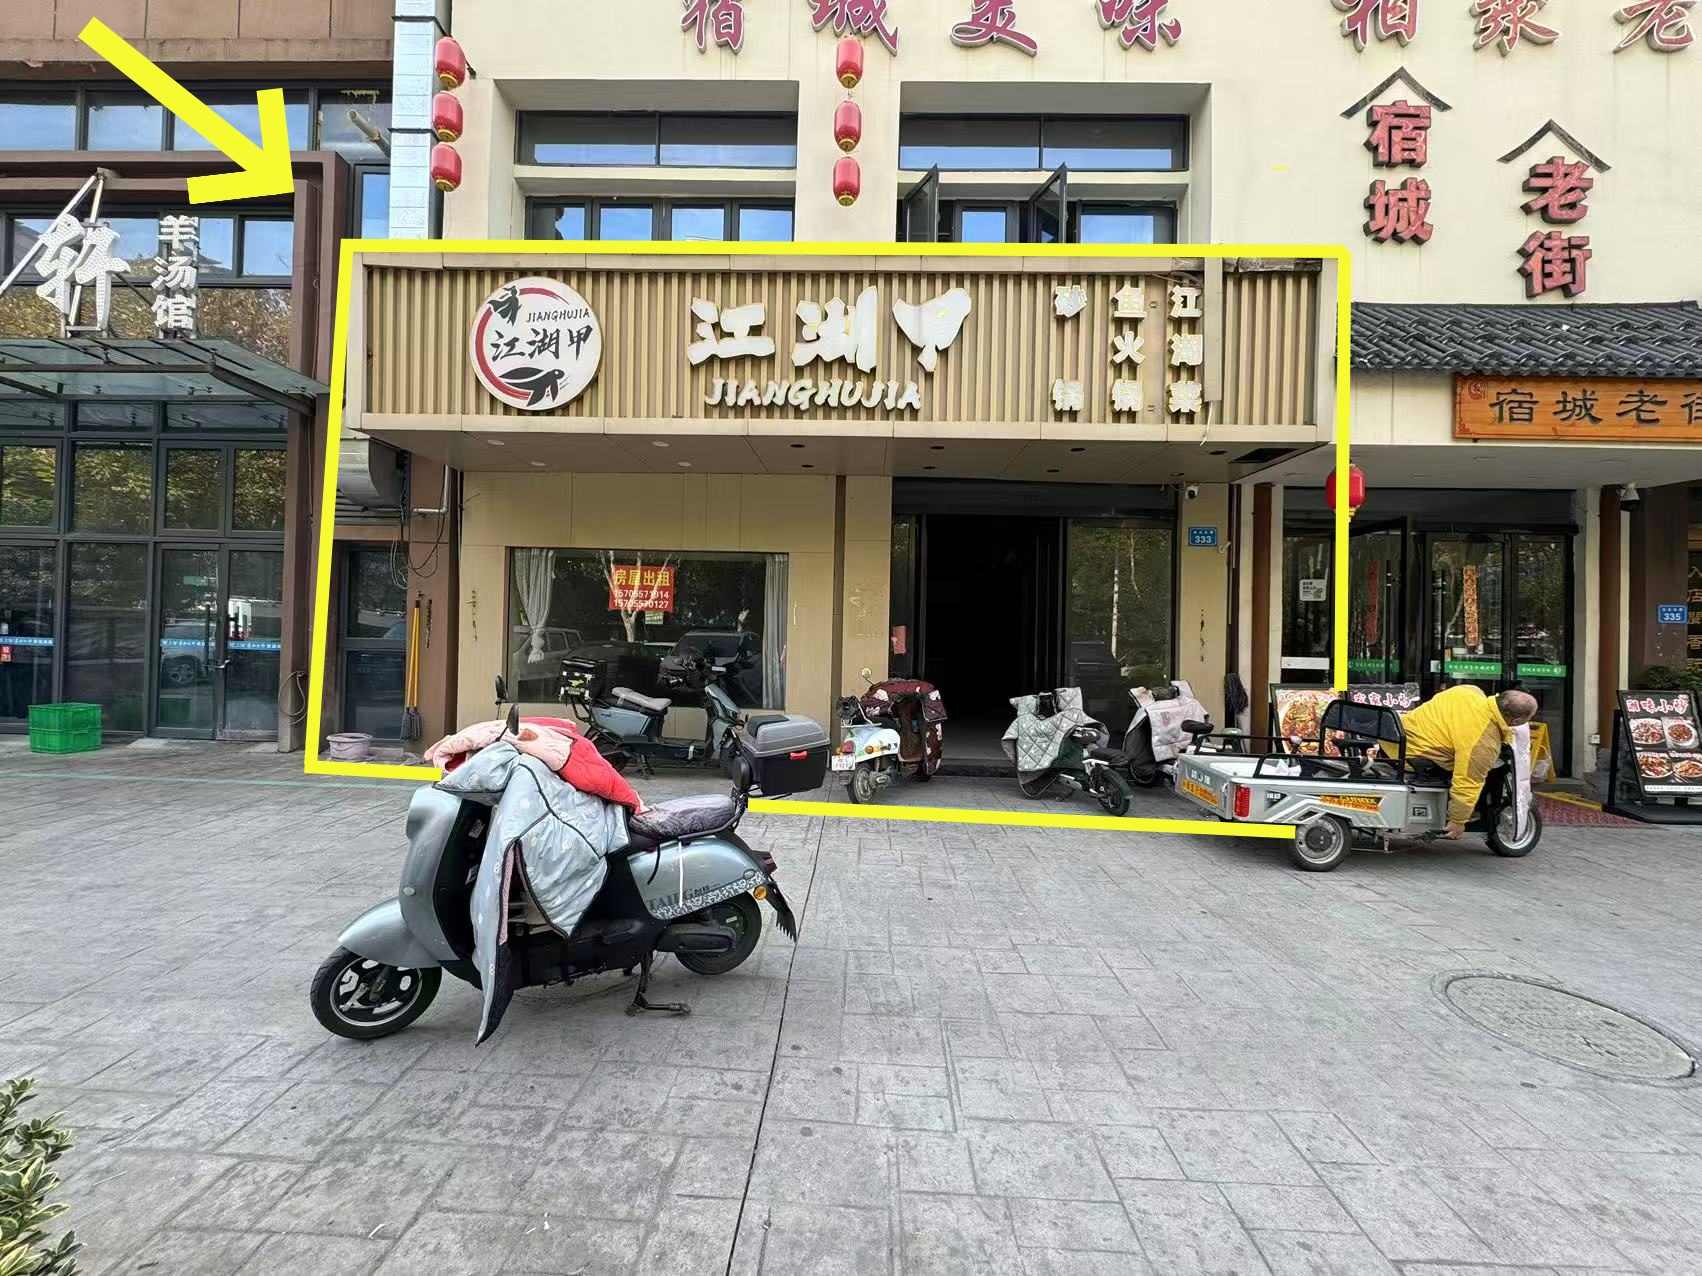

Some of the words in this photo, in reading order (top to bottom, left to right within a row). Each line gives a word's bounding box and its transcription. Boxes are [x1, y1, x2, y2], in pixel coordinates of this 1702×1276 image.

[1363, 100, 1433, 246] 宿城
[1516, 156, 1594, 298] 老街
[151, 215, 199, 330] 羊汤馆
[526, 308, 591, 323] JIANGHUJIA
[688, 285, 972, 374] 江湖甲
[490, 324, 594, 362] 江湖甲
[705, 377, 921, 411] JIANGHUJIA
[1195, 535, 1212, 544] 333
[613, 568, 670, 586] 房屋出租
[1663, 612, 1682, 621] 335
